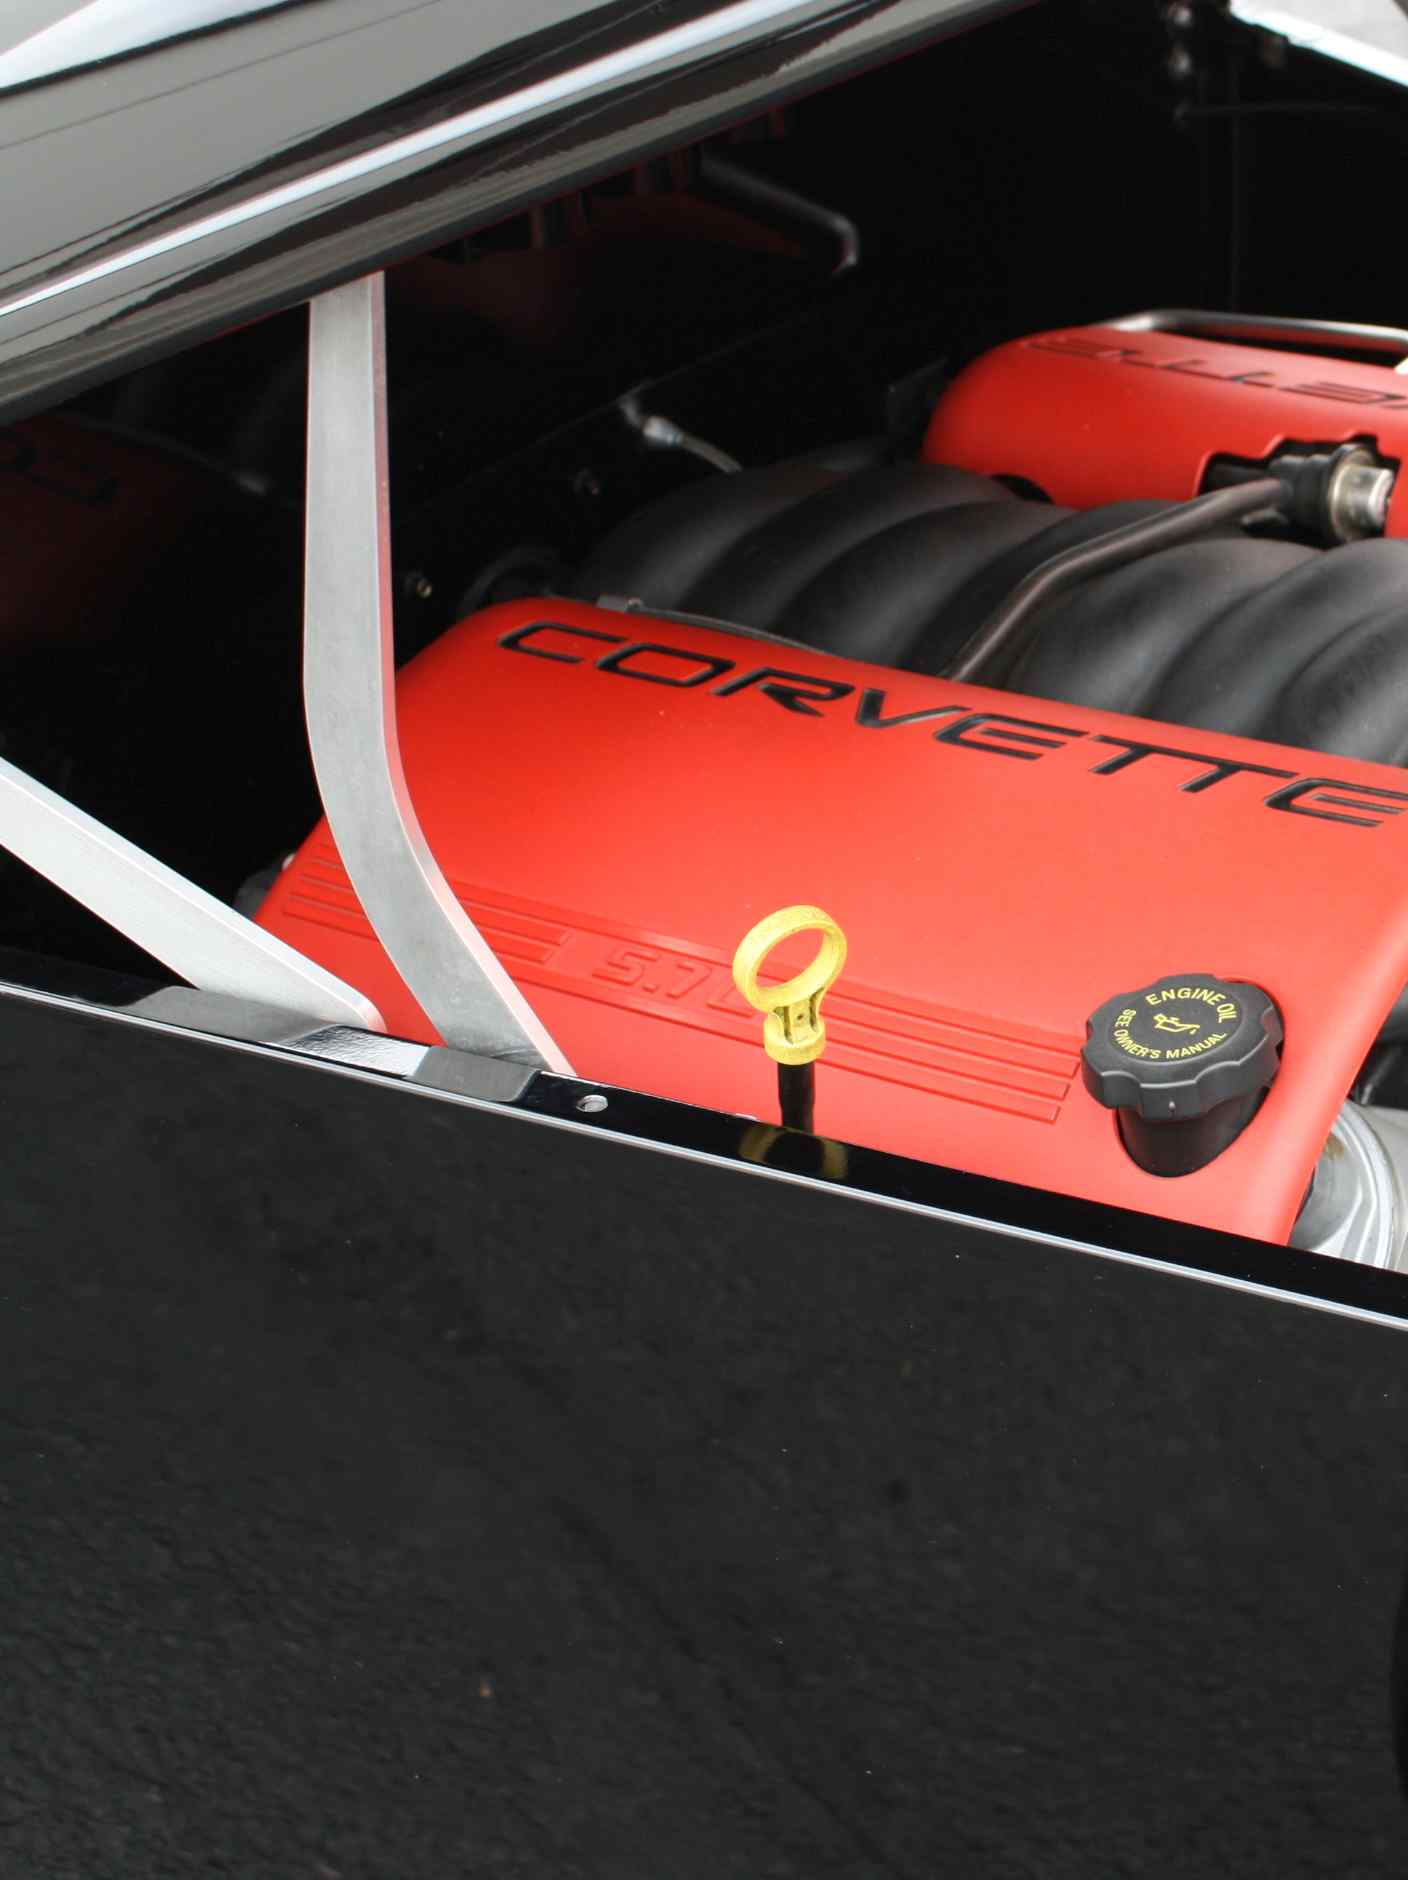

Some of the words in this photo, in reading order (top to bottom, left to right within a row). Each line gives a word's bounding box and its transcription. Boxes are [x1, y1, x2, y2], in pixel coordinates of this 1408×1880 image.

[1114, 1008, 1137, 1028] SEE
[1145, 987, 1226, 1006] ENGINE
[1216, 1003, 1238, 1024] OIL
[1113, 1028, 1161, 1059] OWNER'S
[1166, 1032, 1228, 1059] MANUAL
